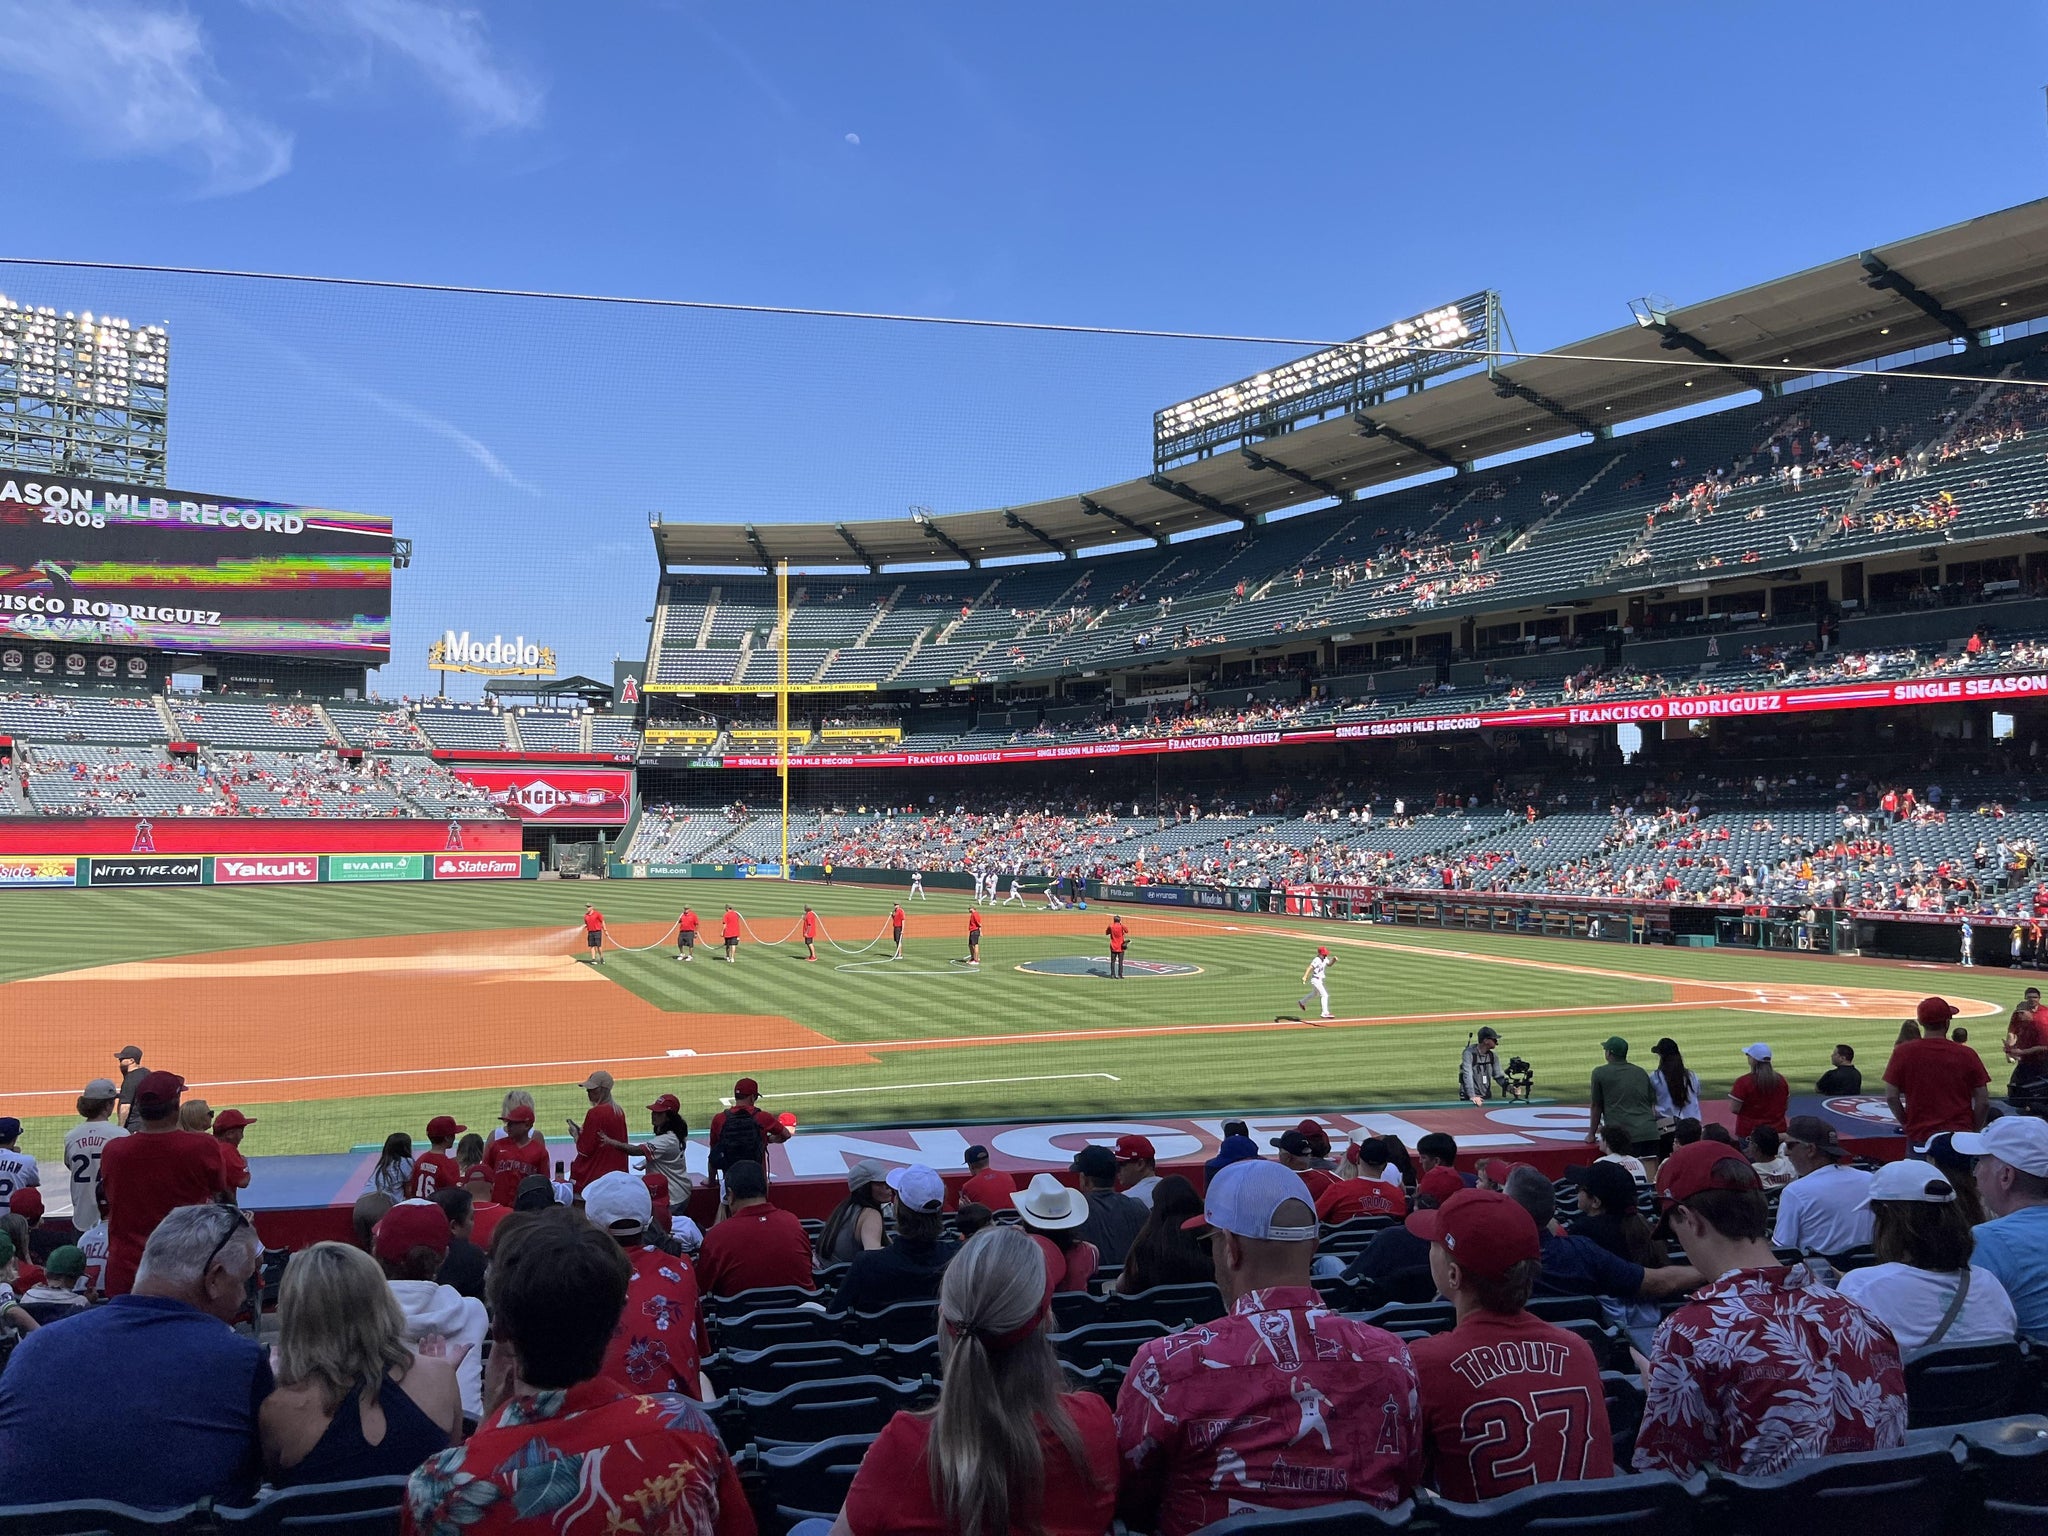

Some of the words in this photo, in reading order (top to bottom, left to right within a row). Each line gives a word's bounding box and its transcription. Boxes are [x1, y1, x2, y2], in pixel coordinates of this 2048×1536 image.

[42, 507, 106, 529] 2008
[105, 491, 170, 519] MLB
[180, 501, 304, 535] RECORD
[72, 598, 222, 626] RODRIGUEZ
[15, 613, 46, 630] 62
[445, 630, 540, 666] Modelo
[5, 653, 21, 663] 26
[37, 656, 53, 665] 29
[68, 657, 84, 667] 30
[99, 659, 115, 669] 42
[130, 661, 146, 671] 50
[1893, 682, 1962, 700] SINGLE
[1965, 675, 2047, 695] SEASON
[1569, 704, 1664, 724] FRANCISCO
[1668, 695, 1781, 717] RODRIGUEZ
[1335, 726, 1369, 738] SINGLE
[1371, 723, 1411, 735] SEASON
[1412, 721, 1435, 733] MLB
[1436, 717, 1481, 730] RECORD
[1168, 737, 1219, 750] FRANCISCO
[1221, 733, 1281, 746] RODRIGUEZ
[613, 754, 631, 762] 4:04
[907, 754, 955, 764] FRANCISCO
[956, 752, 1001, 763] RODRIGUEZ
[1036, 749, 1057, 758] SINGLE
[1057, 746, 1081, 756] SEASON
[1081, 746, 1094, 755] MLB
[1094, 744, 1120, 754] RECORD
[738, 757, 768, 766] SINGLE
[803, 757, 820, 766] MLB
[821, 757, 854, 765] RECORD
[506, 782, 573, 806] ANGELS
[94, 864, 135, 877] NITTO
[138, 864, 199, 876] TIRE.COM
[222, 861, 312, 877] Yakult
[343, 862, 369, 870] EVA
[370, 862, 394, 870] AIR
[1110, 889, 1134, 897] FMB.com
[1155, 892, 1178, 900] HYUNDAI
[1201, 892, 1222, 905] Modelo
[76, 1136, 107, 1149] TROUT
[415, 1173, 436, 1198] 16
[1359, 1195, 1393, 1210] TROUT
[1450, 1341, 1570, 1389] TROUT
[1460, 1386, 1595, 1504] 27
[1267, 1453, 1348, 1492] ANGELS
